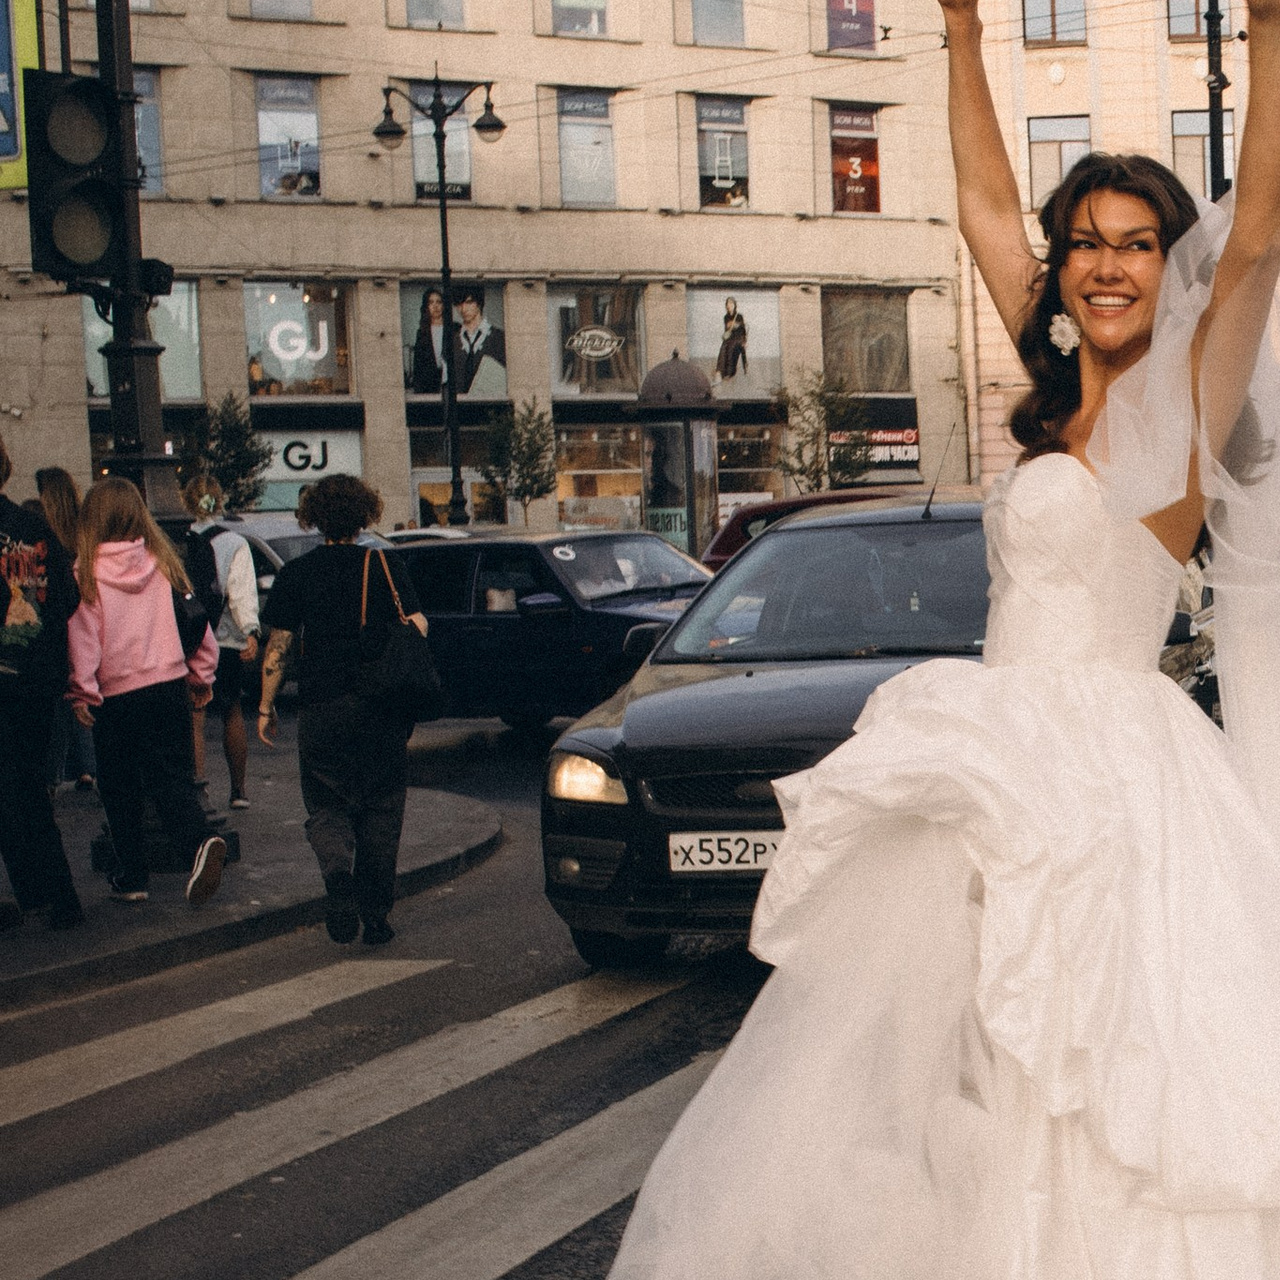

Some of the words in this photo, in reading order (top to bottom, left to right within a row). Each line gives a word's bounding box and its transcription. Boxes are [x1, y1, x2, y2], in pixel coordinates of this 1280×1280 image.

[848, 157, 862, 179] 3
[269, 320, 329, 361] GJ
[283, 441, 328, 471] GJ
[680, 838, 777, 866] Х552Р
